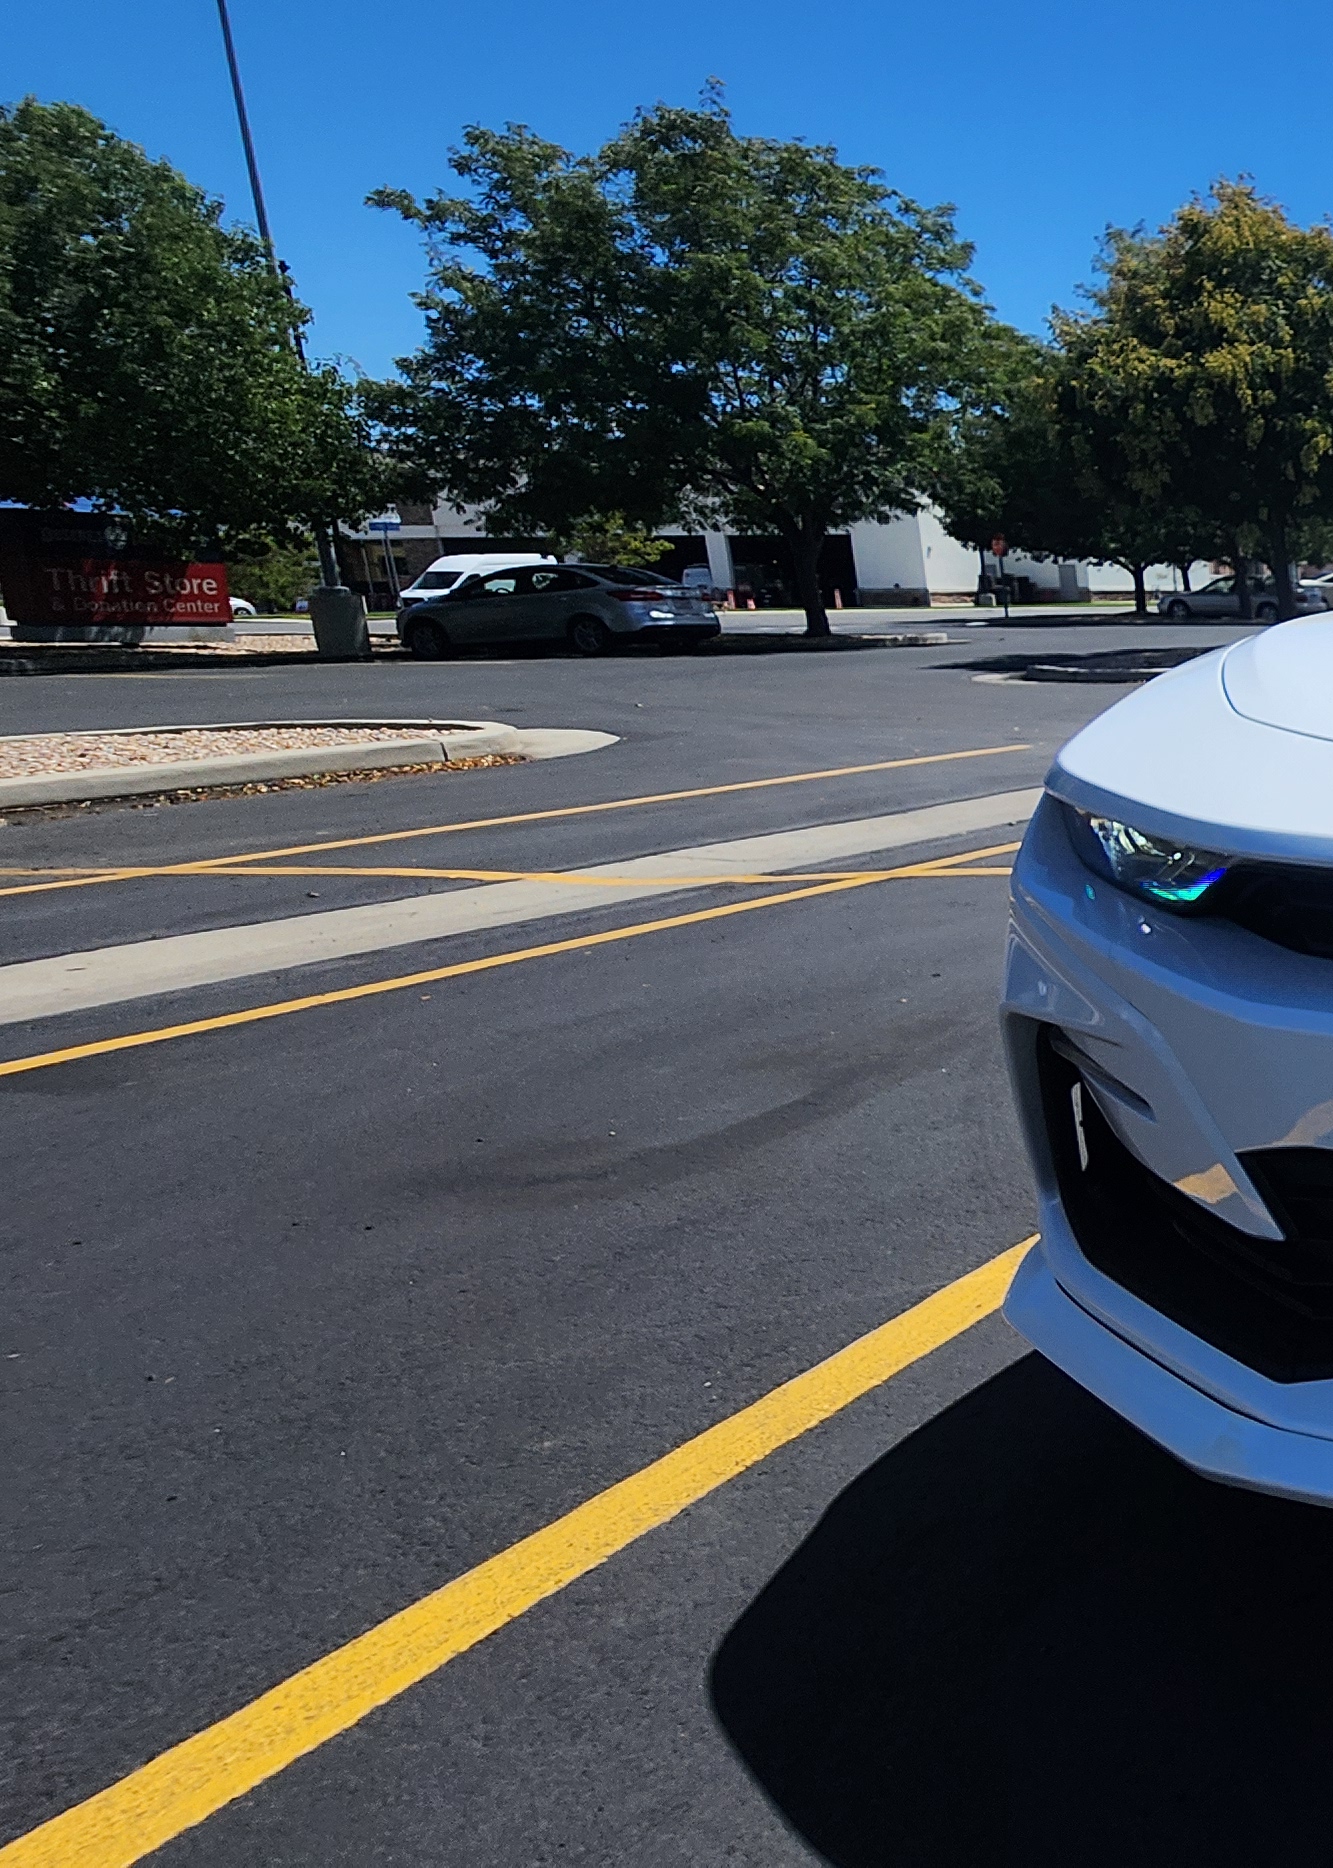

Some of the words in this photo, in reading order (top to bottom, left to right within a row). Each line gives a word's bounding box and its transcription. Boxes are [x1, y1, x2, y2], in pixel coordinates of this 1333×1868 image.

[45, 567, 133, 594] Thrift
[144, 570, 219, 595] Store
[74, 597, 159, 613] Donation
[162, 598, 220, 613] Center
